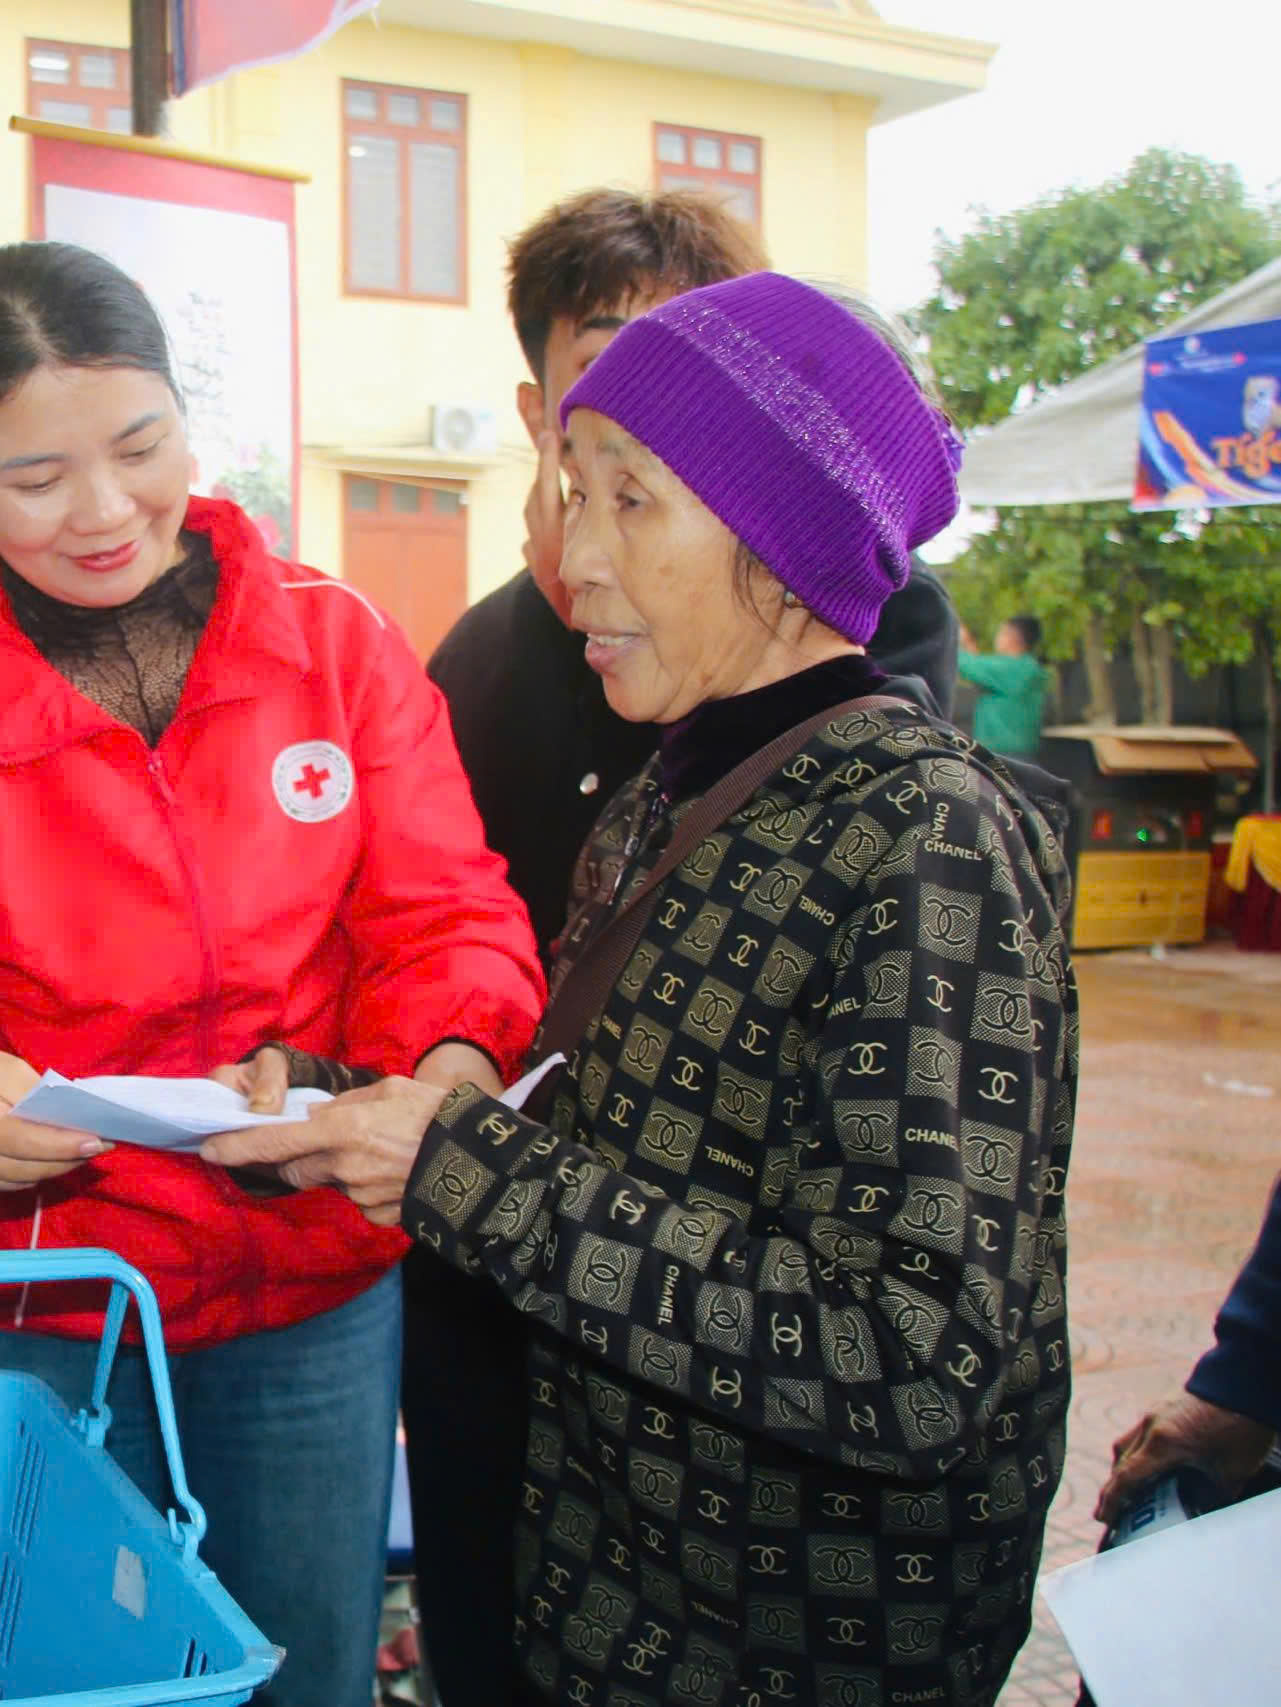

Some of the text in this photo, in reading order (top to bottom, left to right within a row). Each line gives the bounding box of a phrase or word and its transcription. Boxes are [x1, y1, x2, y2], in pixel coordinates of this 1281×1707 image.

[923, 839, 982, 861] CHANEL
[704, 1144, 755, 1178] CHANEL
[656, 1264, 680, 1326] CHANEL
